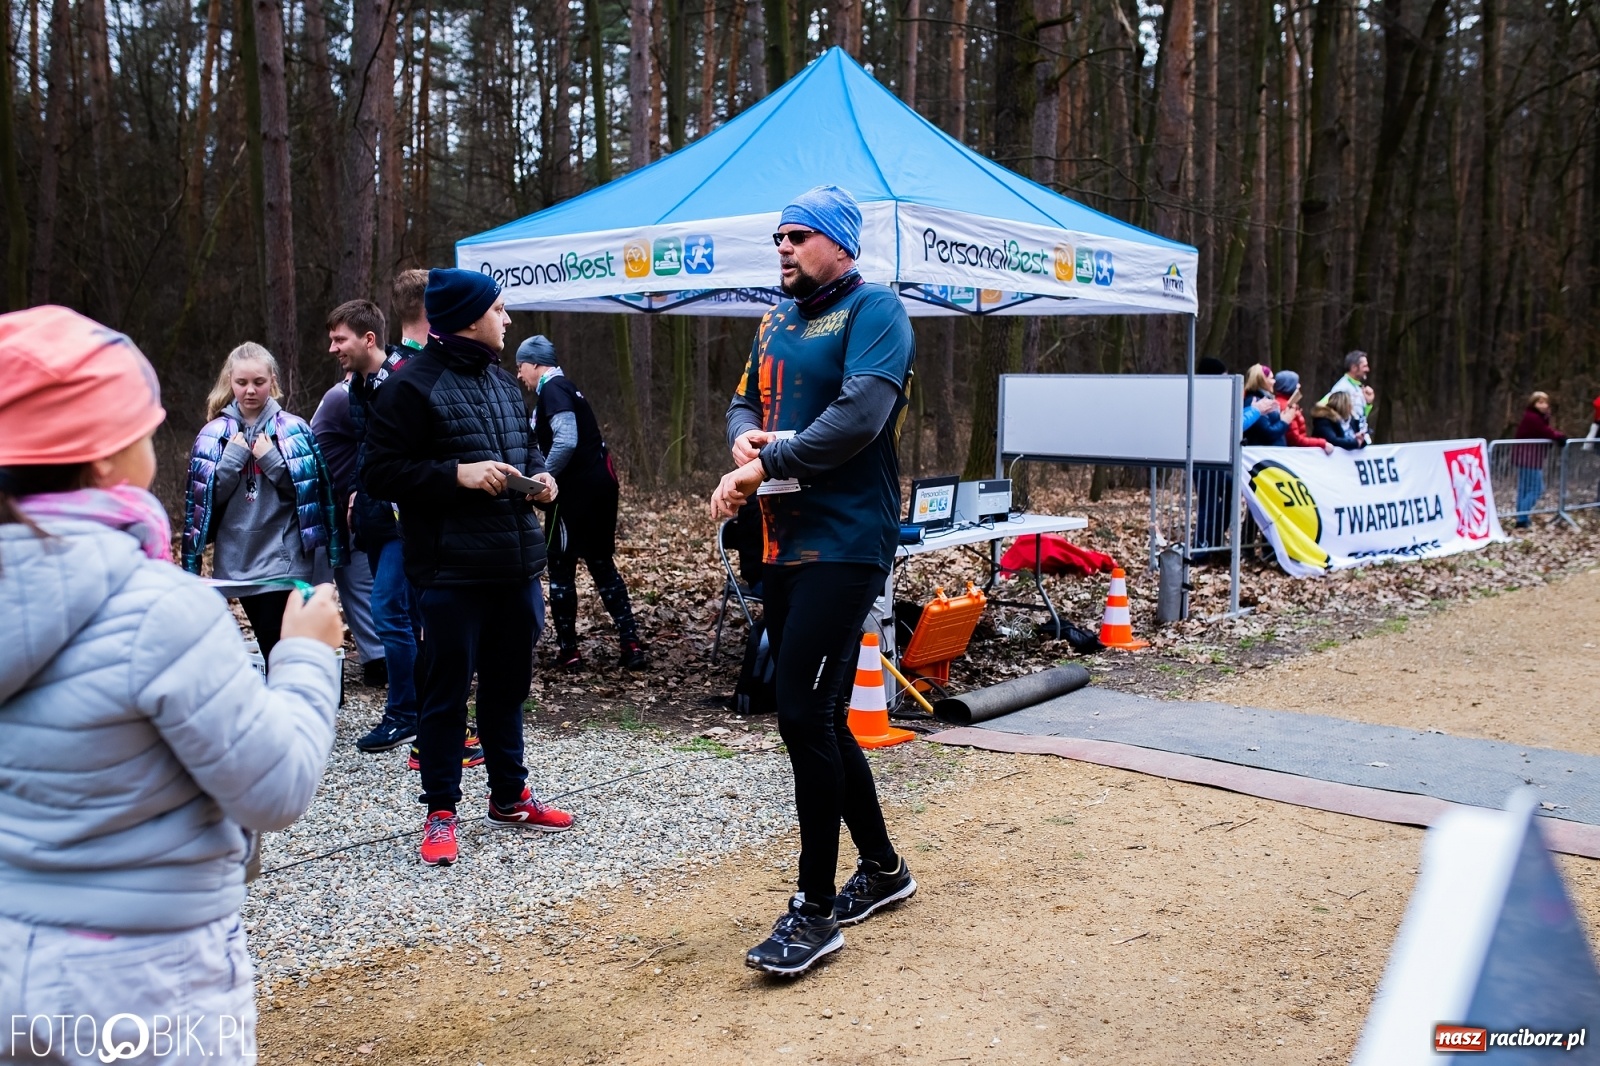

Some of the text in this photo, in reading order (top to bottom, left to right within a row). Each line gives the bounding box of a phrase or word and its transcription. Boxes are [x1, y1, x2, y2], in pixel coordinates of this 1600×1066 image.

[923, 228, 1049, 275] PersonalBest
[1354, 457, 1399, 486] BIEG
[1275, 481, 1316, 507] SIR
[1334, 494, 1443, 536] TWARDZIELA
